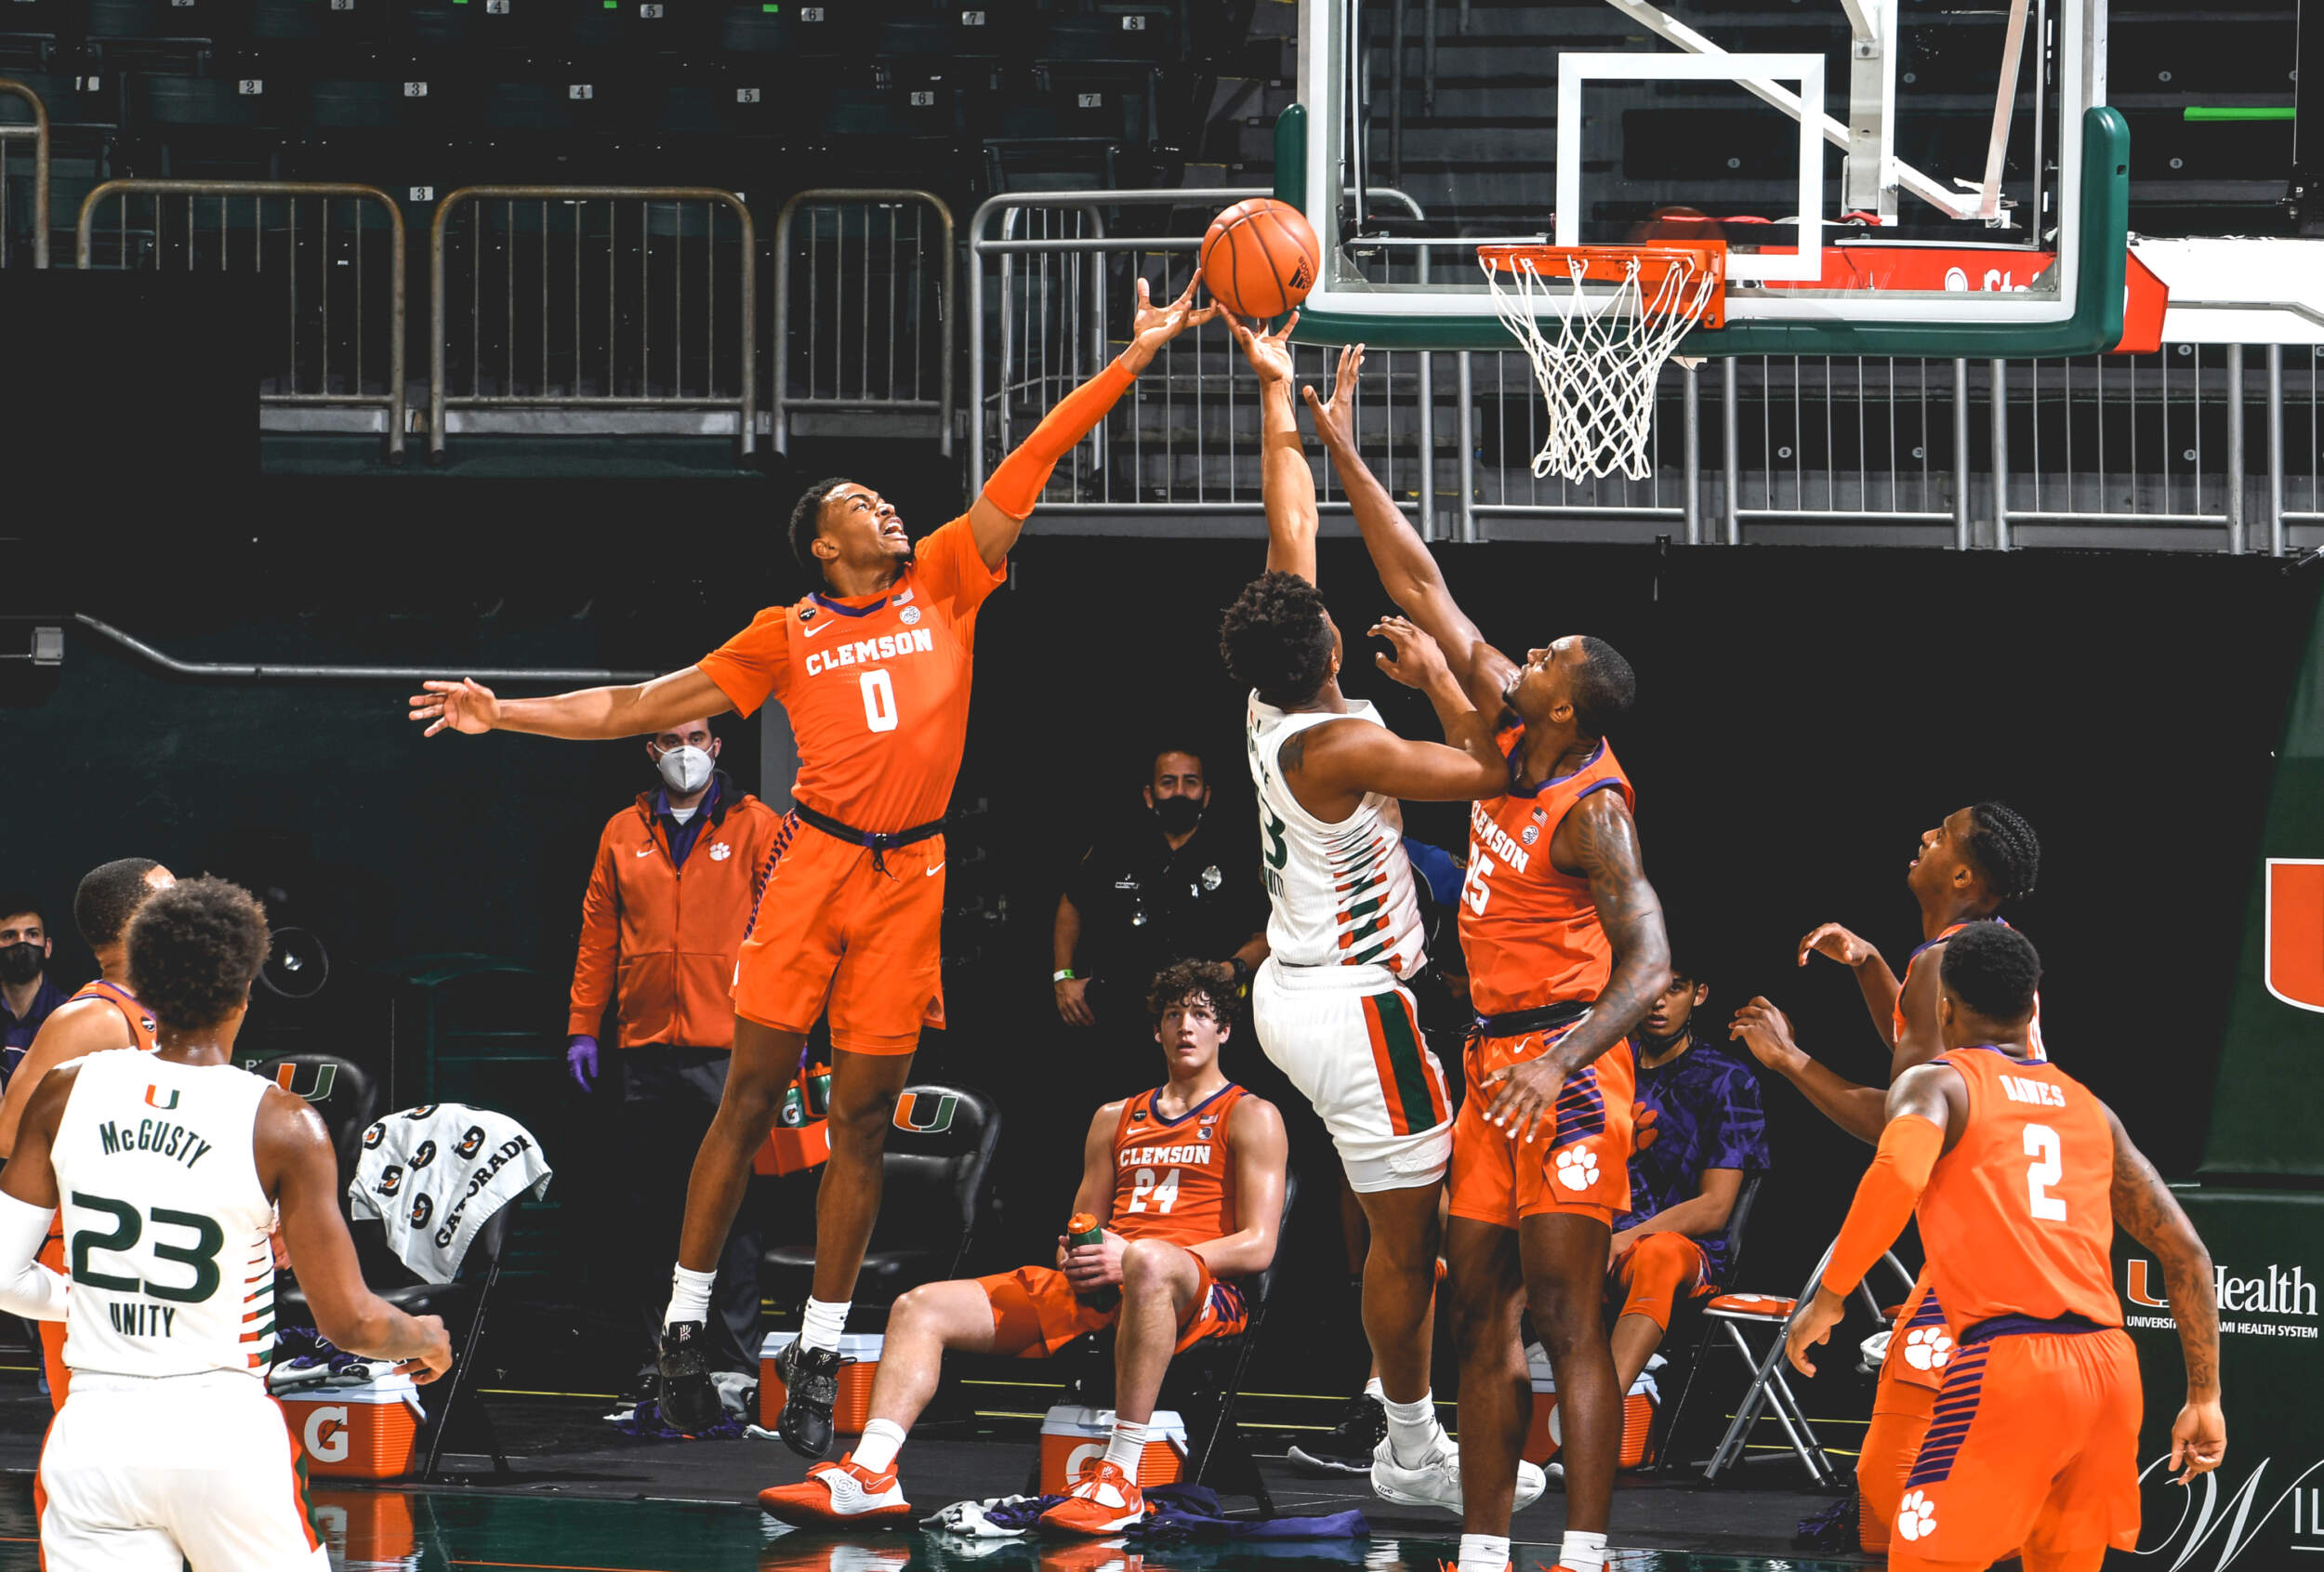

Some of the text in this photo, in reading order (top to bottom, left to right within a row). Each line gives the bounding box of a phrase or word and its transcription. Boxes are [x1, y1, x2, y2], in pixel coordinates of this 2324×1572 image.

[494, 0, 502, 13] 4
[647, 5, 655, 18] 5
[809, 9, 817, 21] 6
[970, 12, 977, 24] 7
[1129, 17, 1139, 30] 8
[245, 81, 255, 93] 2
[411, 83, 420, 97] 3
[576, 86, 585, 99] 4
[745, 89, 753, 102] 5
[918, 92, 927, 105] 6
[1085, 95, 1094, 106] 7
[417, 187, 426, 200] 3
[805, 628, 933, 677] CLEMSON
[859, 668, 899, 733] 0
[1461, 840, 1495, 917] 25
[276, 1063, 337, 1102] U
[1999, 1075, 2066, 1107] DAWES
[145, 1084, 180, 1110] U
[893, 1092, 958, 1132] U
[99, 1118, 212, 1169] McGUSTY
[1120, 1145, 1211, 1167] CLEMSON
[2023, 1123, 2067, 1222] 2
[1128, 1168, 1181, 1213] 24
[72, 1190, 224, 1303] 23
[110, 1302, 176, 1338] UNITY
[2238, 1322, 2276, 1335] HEALTH
[2278, 1325, 2318, 1339] SYSTEM
[304, 1406, 349, 1462] G
